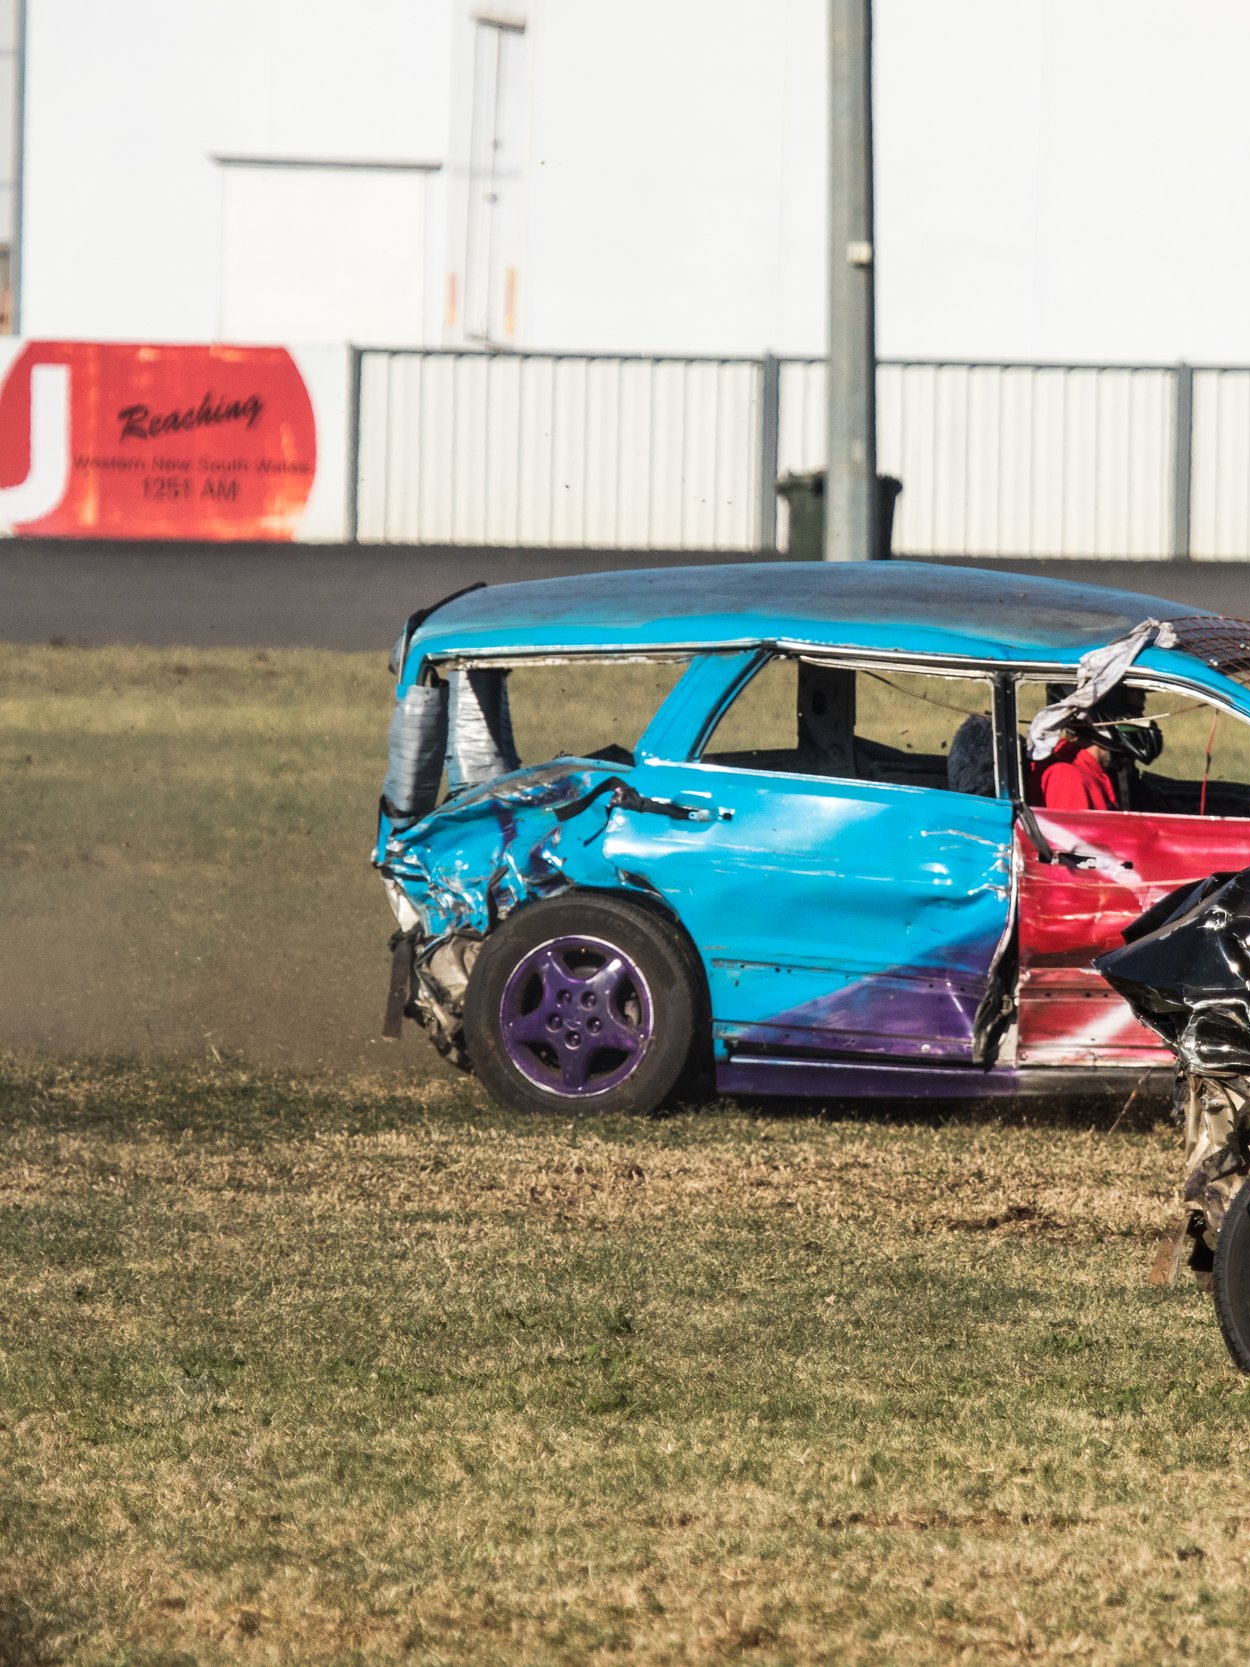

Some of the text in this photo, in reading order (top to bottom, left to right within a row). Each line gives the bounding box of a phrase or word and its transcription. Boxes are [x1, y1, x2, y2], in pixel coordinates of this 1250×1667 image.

[117, 390, 265, 443] Reaching
[152, 456, 190, 471] New
[200, 457, 248, 473] South
[142, 476, 240, 502] 1251 AM
